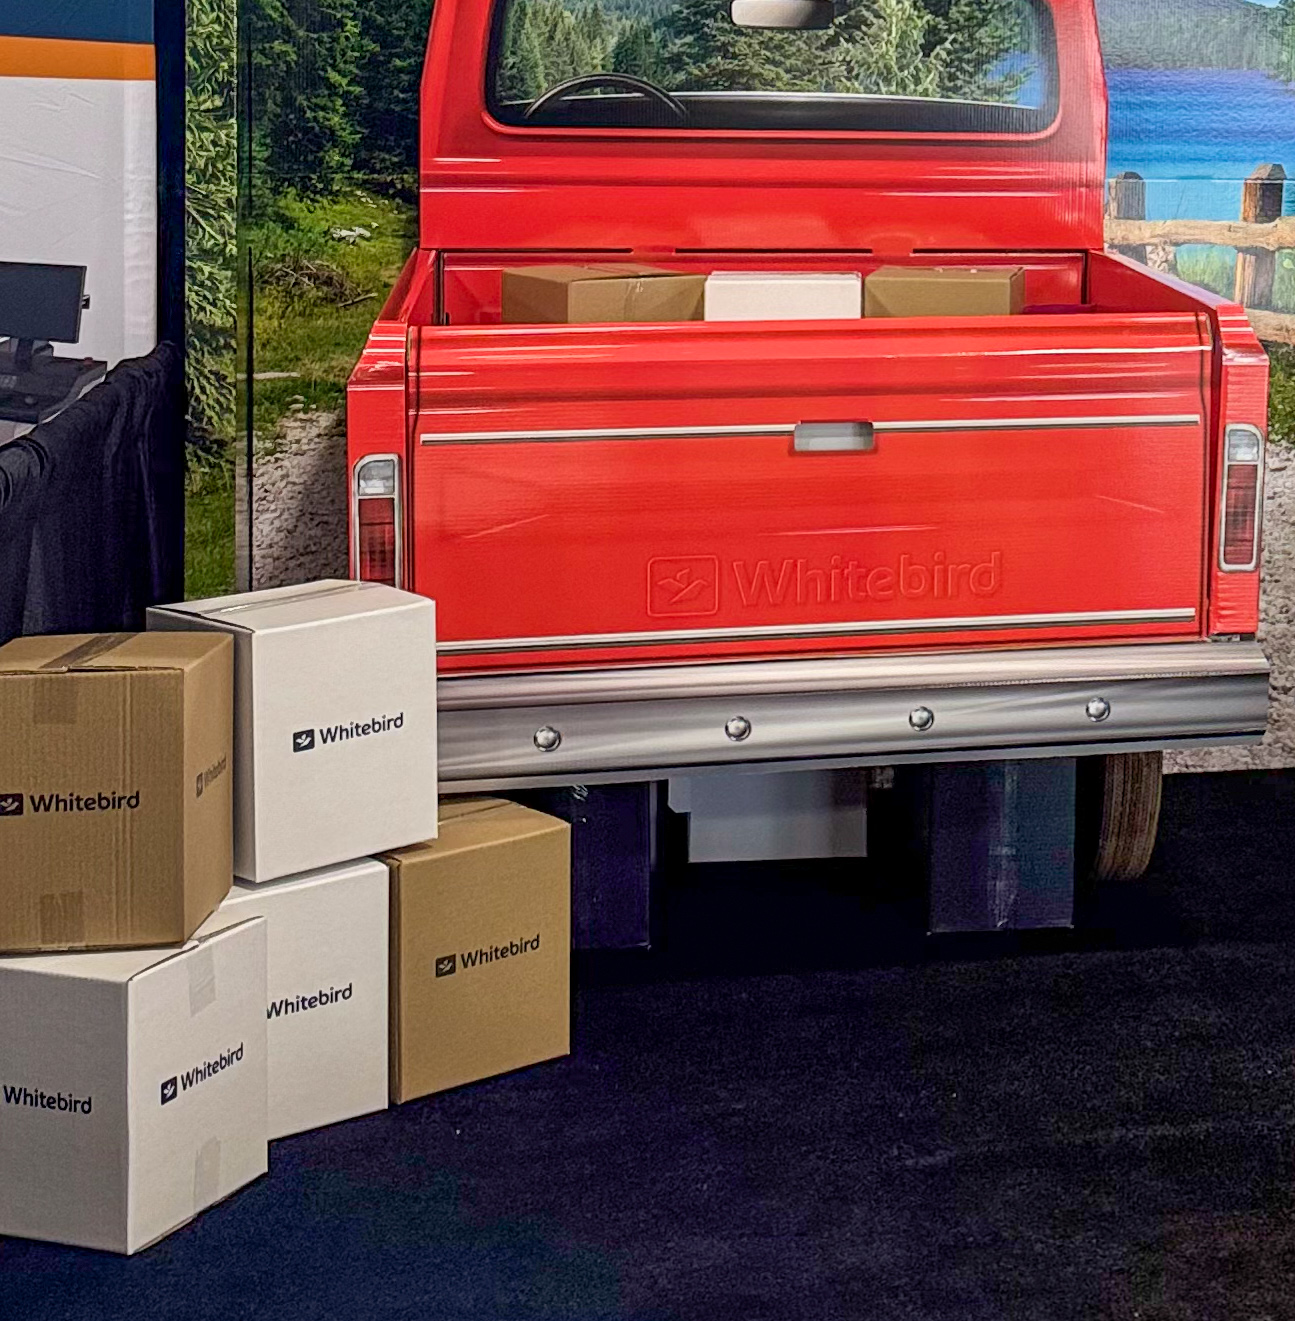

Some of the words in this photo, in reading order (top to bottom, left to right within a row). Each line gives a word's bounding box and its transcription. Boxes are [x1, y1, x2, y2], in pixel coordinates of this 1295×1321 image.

[732, 551, 1002, 606] Whitebird
[318, 712, 404, 745] Whitebird
[29, 790, 140, 814] Whitebird
[460, 933, 541, 969] Whitebird
[265, 982, 353, 1020] Whitebird
[180, 1042, 245, 1092] Whitebird
[3, 1085, 93, 1115] Whitebird
